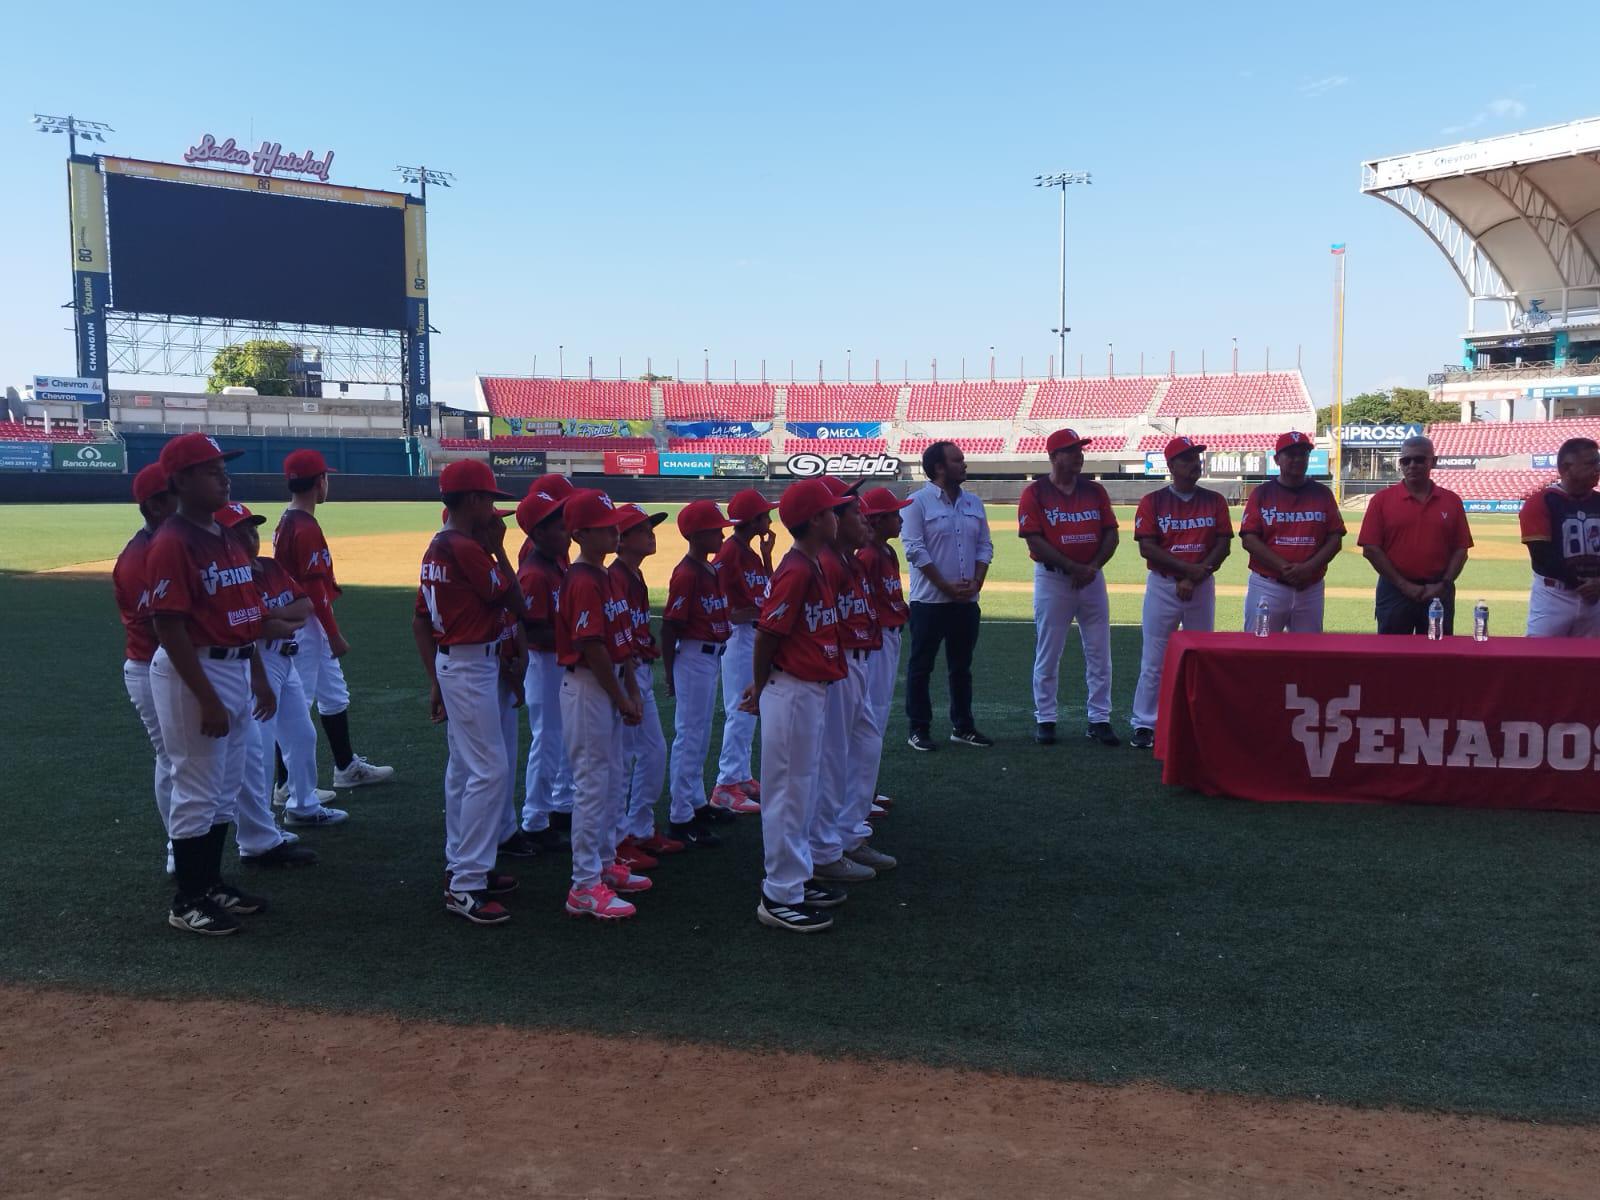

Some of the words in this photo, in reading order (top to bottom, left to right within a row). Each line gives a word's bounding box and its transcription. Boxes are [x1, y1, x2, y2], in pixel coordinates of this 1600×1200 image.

[184, 133, 250, 165] Salsa
[252, 141, 334, 181] Huichol
[88, 322, 97, 371] CHANGAN
[418, 342, 427, 385] CHANGAN
[51, 379, 89, 389] Chevron
[41, 392, 77, 401] Chevron
[711, 427, 722, 435] LA
[723, 425, 742, 434] LIGA
[829, 428, 861, 438] MEGA
[63, 460, 88, 468] Banco
[89, 460, 117, 468] Azteca
[825, 455, 899, 476] elsiglo
[1436, 458, 1472, 466] UNDER
[1285, 683, 1600, 778] VENADO
